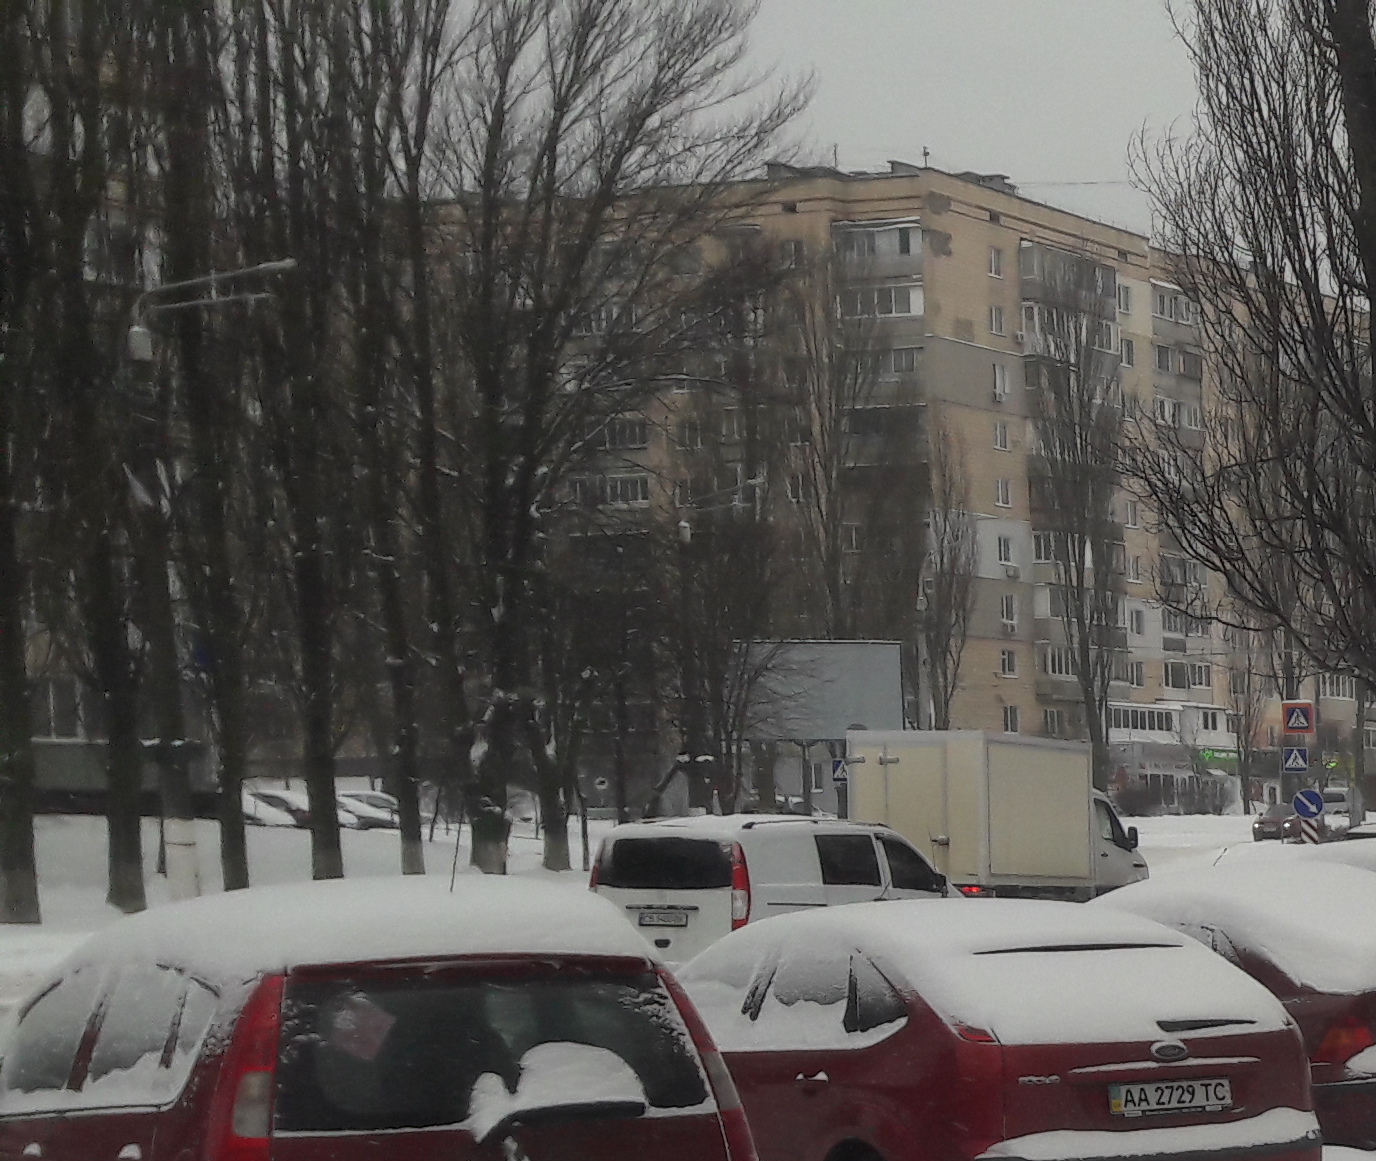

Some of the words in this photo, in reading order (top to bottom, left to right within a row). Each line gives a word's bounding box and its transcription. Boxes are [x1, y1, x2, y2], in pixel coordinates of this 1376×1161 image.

[1124, 1087, 1150, 1108] AA
[1154, 1084, 1196, 1106] 2729
[1200, 1082, 1227, 1102] TC
